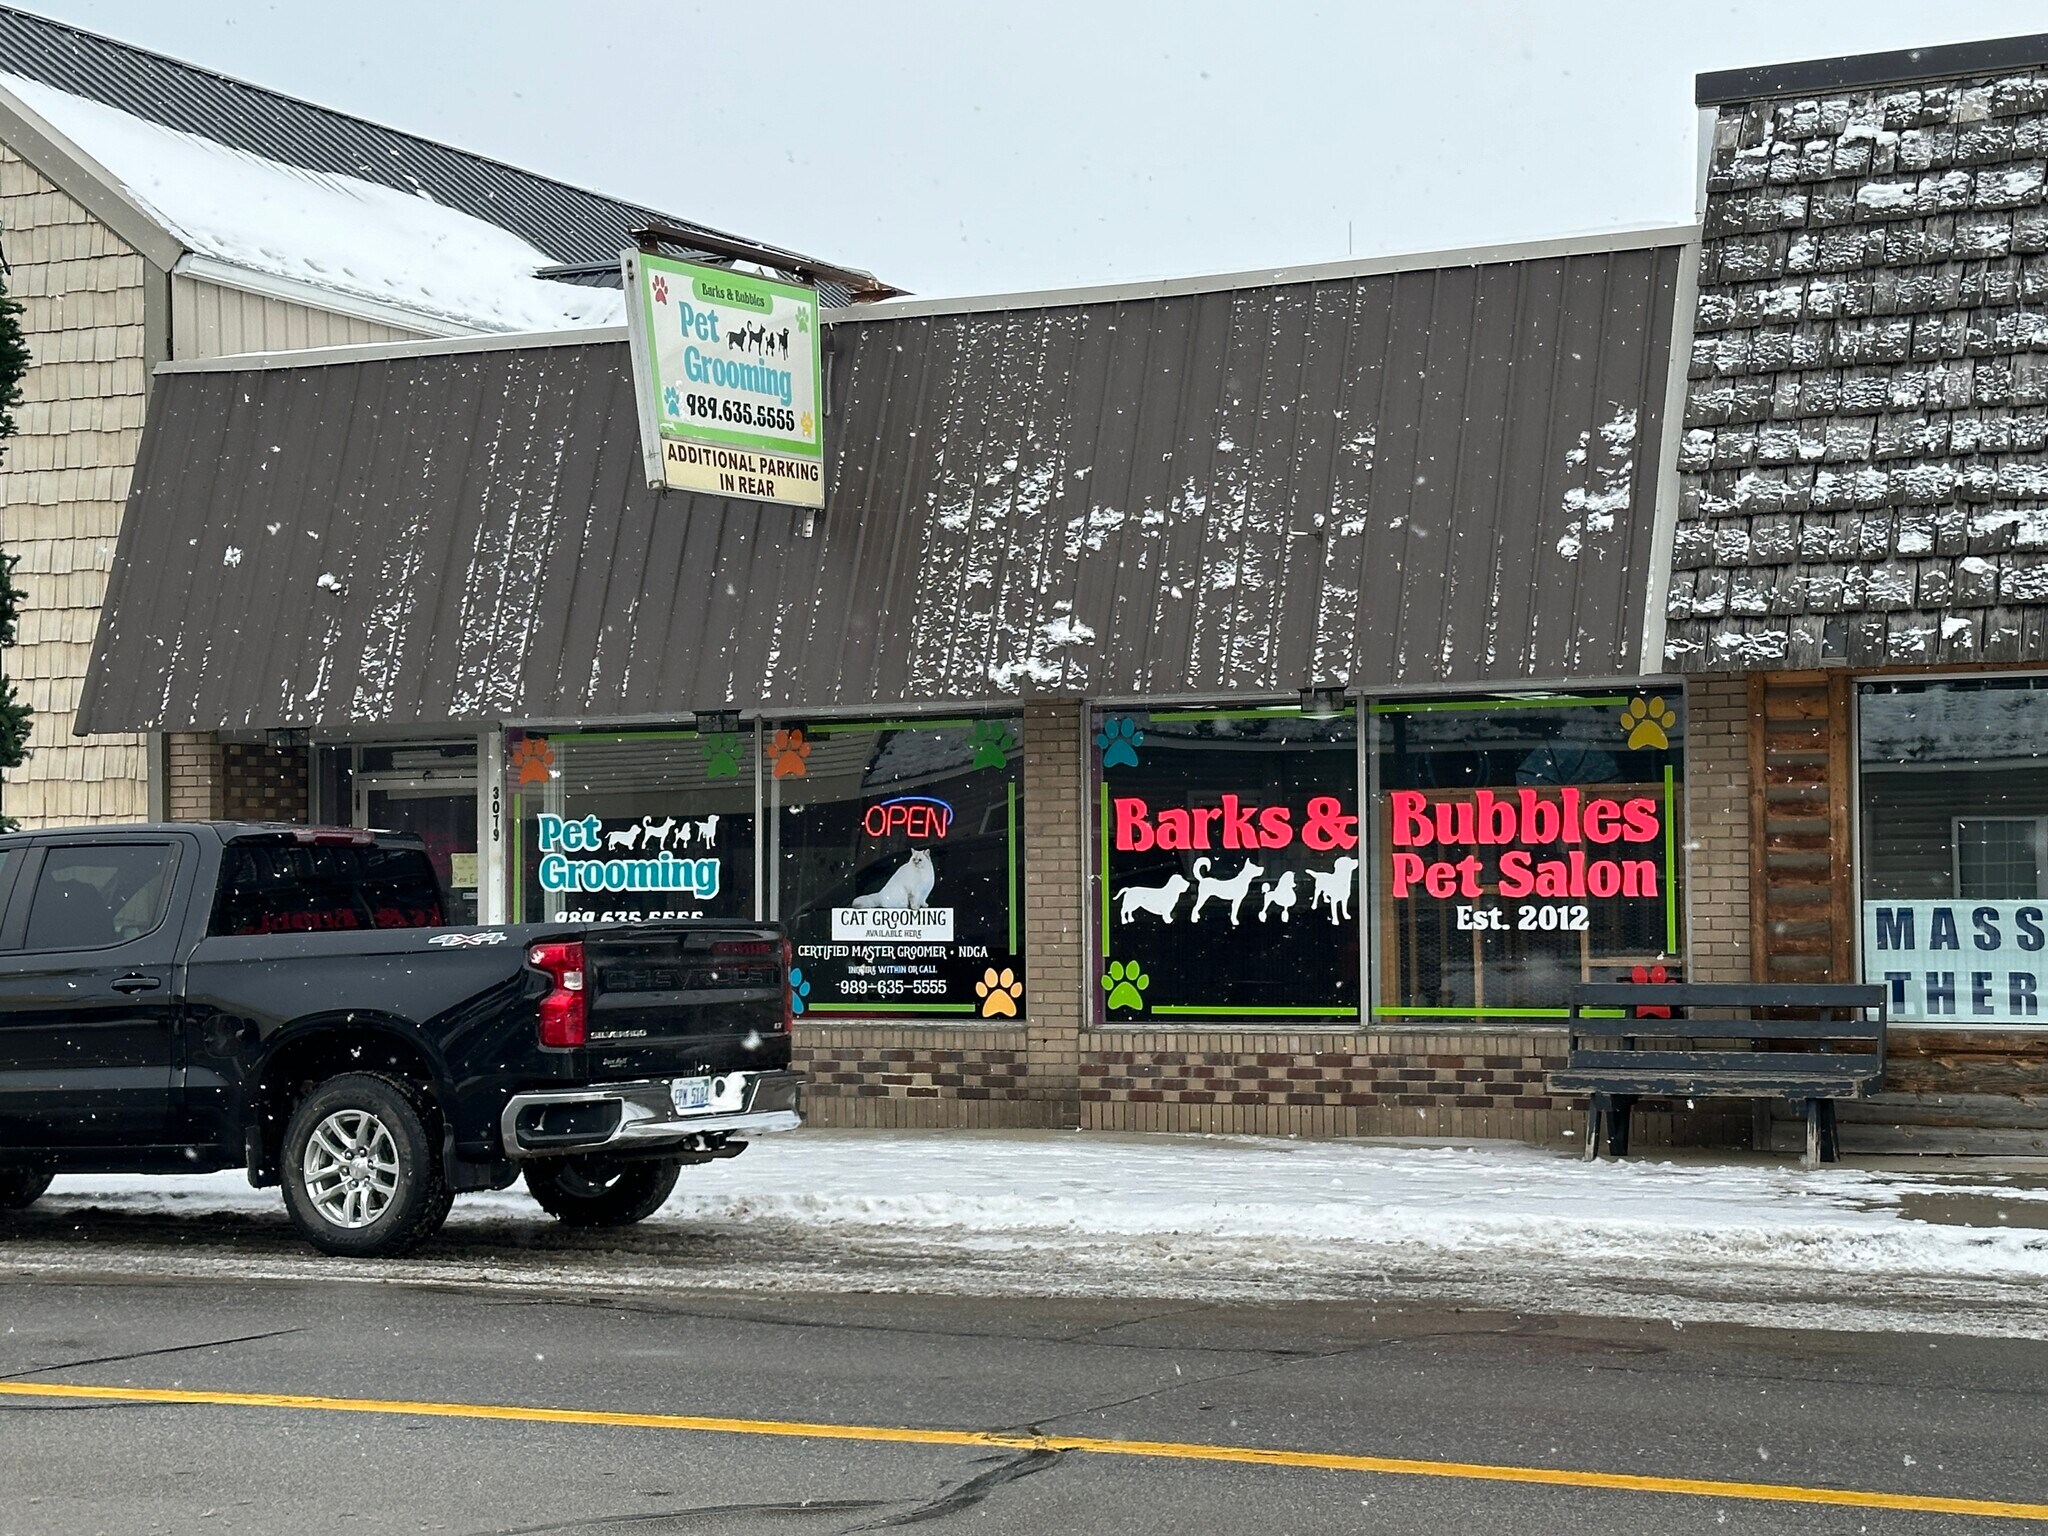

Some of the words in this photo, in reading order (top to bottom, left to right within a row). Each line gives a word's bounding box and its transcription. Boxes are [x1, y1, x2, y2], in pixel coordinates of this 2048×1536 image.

[702, 283, 726, 300] Barks
[727, 288, 734, 300] &
[735, 290, 765, 307] Bubbles
[679, 301, 720, 343] Pet
[684, 345, 792, 407] Grooming
[687, 393, 795, 431] 989.635.5555
[667, 443, 756, 473] ADDITIONAL
[760, 457, 819, 481] PARKING
[720, 473, 734, 492] IN
[739, 476, 775, 497] REAR
[537, 813, 602, 852] Pet
[865, 805, 947, 838] OPEN
[1114, 794, 1293, 851] Barks
[1302, 796, 1358, 850] &
[1391, 787, 1660, 847] Bubbles
[539, 850, 721, 900] Grooming
[1392, 853, 1484, 898] Pet
[1499, 850, 1659, 898] Salon
[841, 910, 868, 926] CAT
[872, 910, 946, 929] GROOMING
[865, 930, 903, 938] AVAILABLE
[904, 930, 922, 939] HERE
[1456, 905, 1510, 930] Est.
[1518, 905, 1590, 931] 2012
[1876, 907, 2046, 951] MASS
[798, 945, 849, 960] CERTIFIED
[851, 945, 896, 963] MASTER
[897, 945, 947, 960] GROOMER
[958, 946, 989, 958] NDGA
[878, 965, 907, 974] WITHIN
[908, 965, 918, 974] OR
[919, 965, 938, 974] CALL
[606, 967, 779, 989] CHEVROLET
[1884, 971, 2038, 1016] THER
[590, 1029, 647, 1039] SILVERADO
